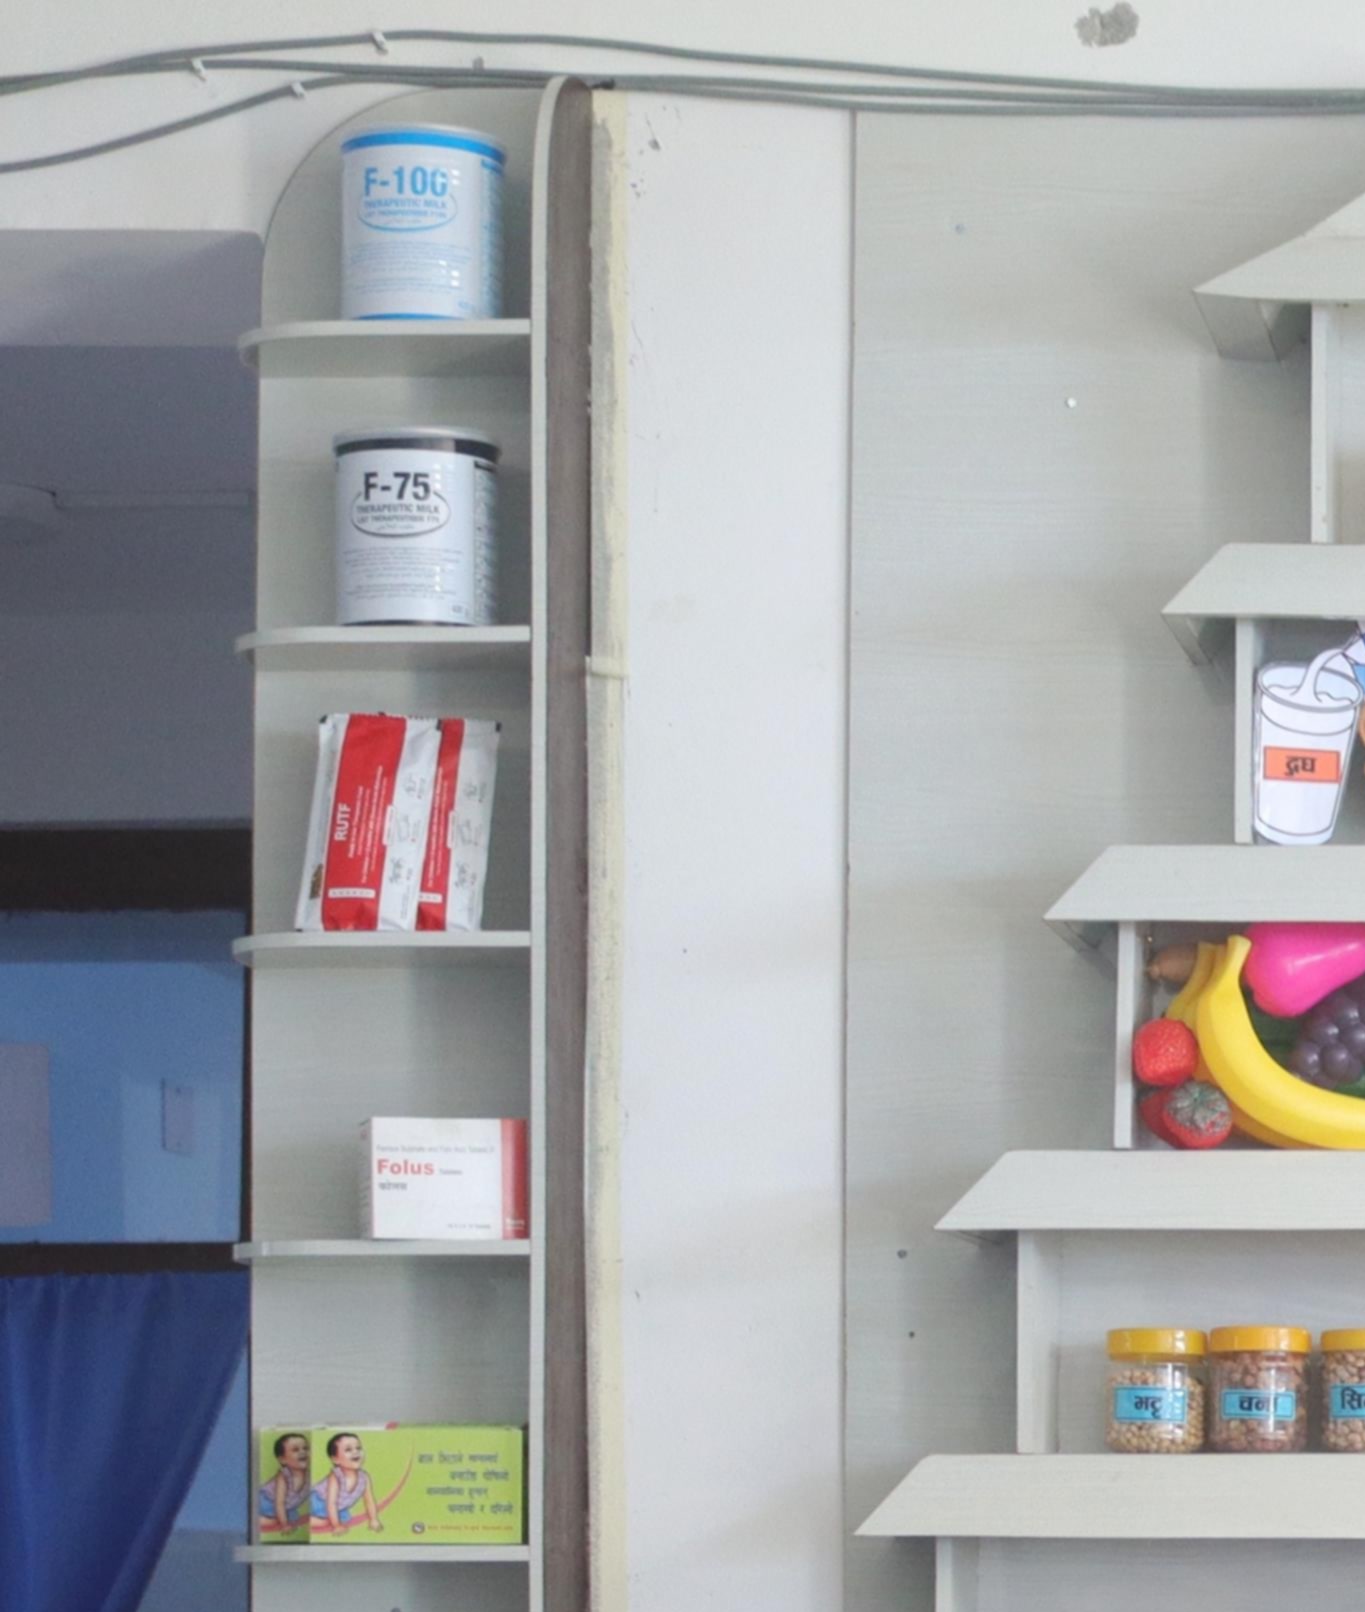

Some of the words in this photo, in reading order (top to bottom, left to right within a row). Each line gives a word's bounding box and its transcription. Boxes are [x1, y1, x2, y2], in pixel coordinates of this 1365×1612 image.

[363, 471, 431, 501] F-75
[333, 802, 352, 842] RUTF
[376, 1158, 434, 1176] Folus
